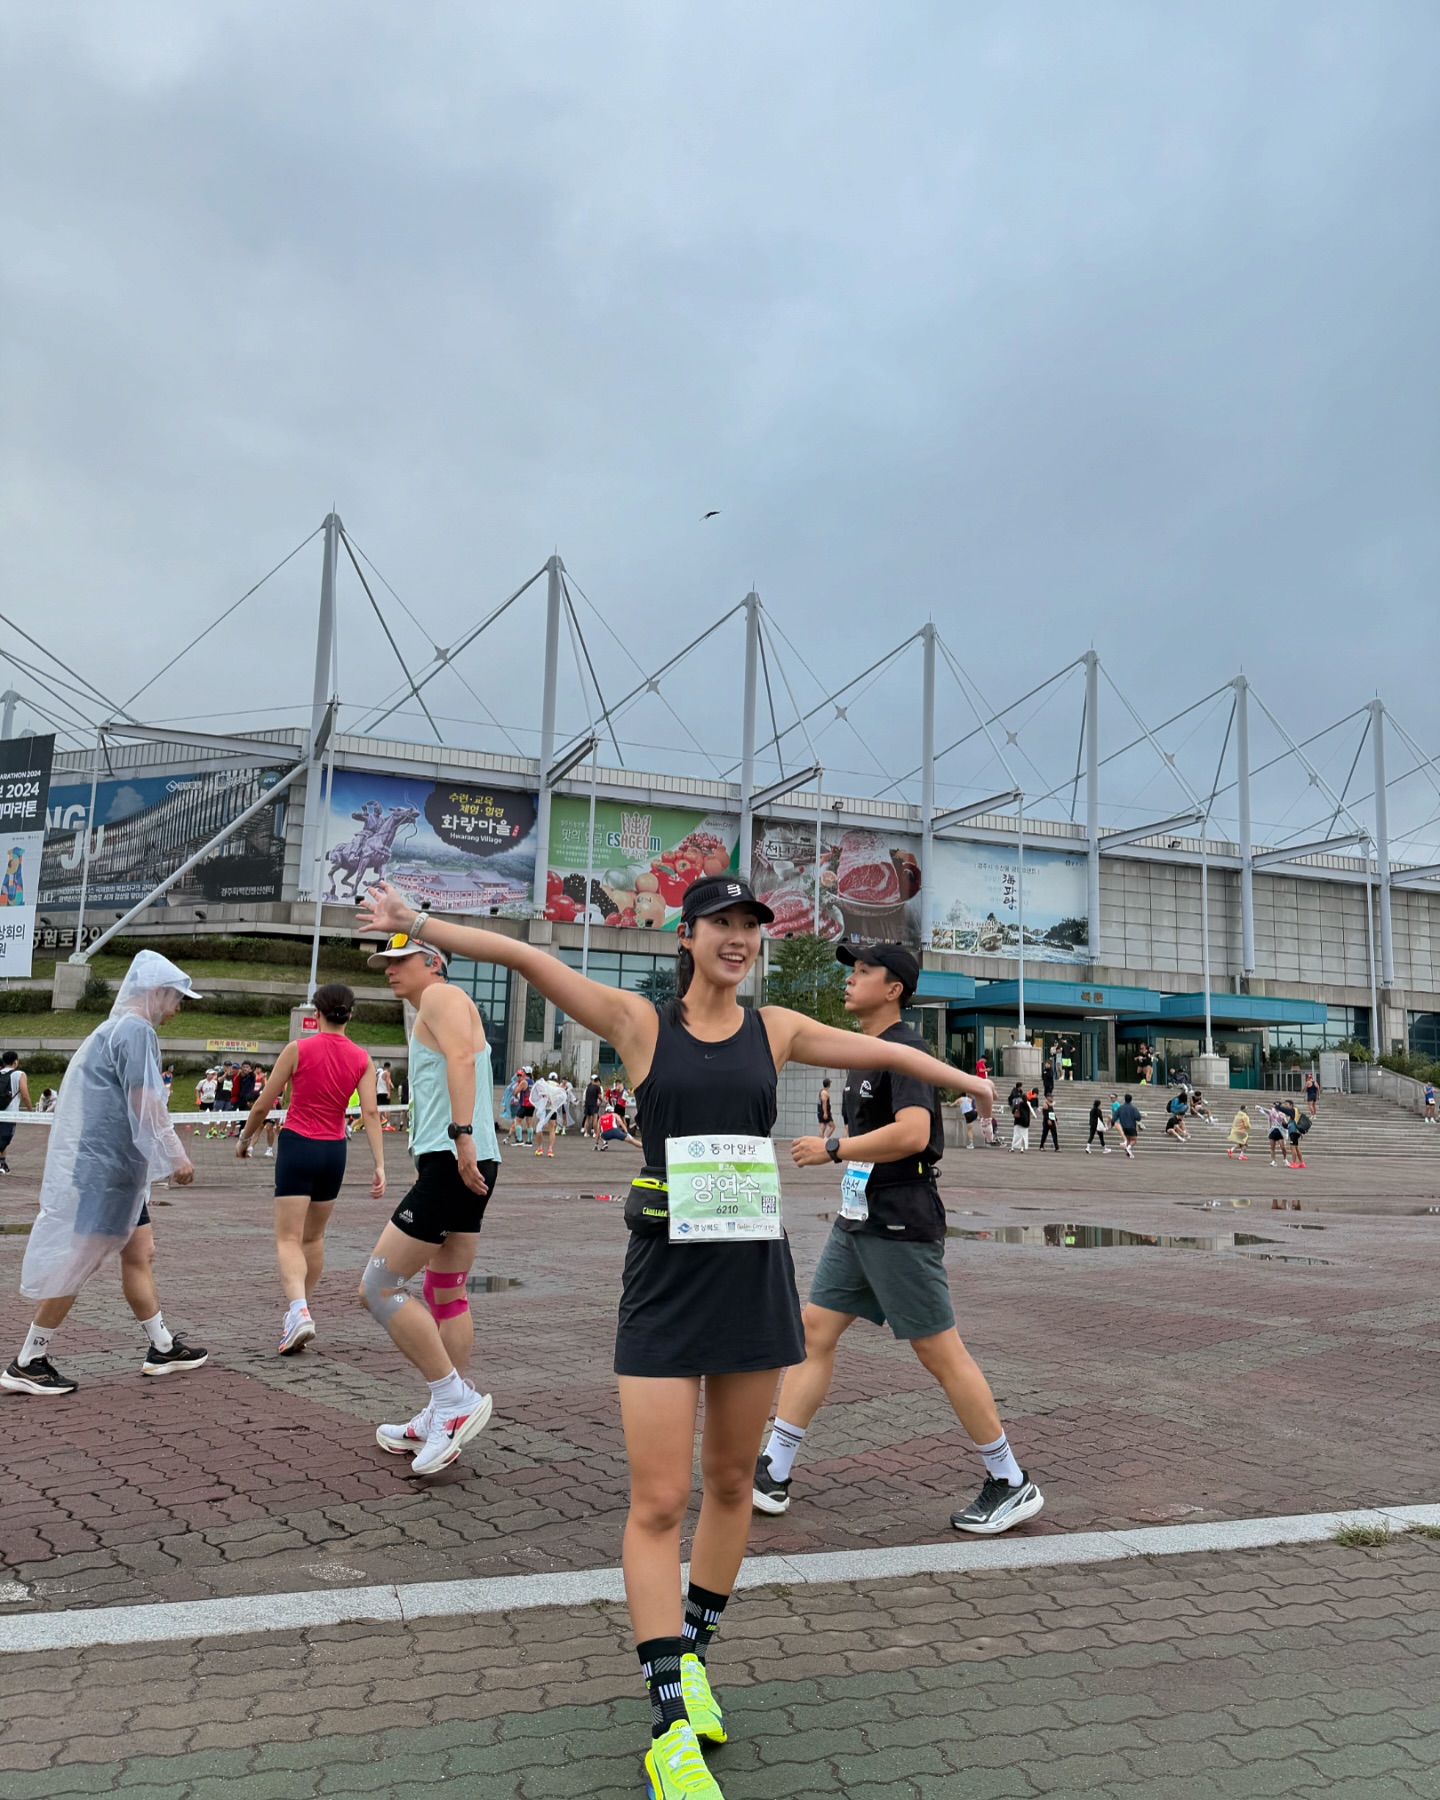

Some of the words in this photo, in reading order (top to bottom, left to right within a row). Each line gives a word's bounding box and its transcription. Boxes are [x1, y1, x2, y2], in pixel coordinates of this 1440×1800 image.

[27, 769, 42, 778] 2024
[6, 781, 40, 798] 2024
[441, 814, 512, 837] 화랑마을
[450, 832, 480, 843] Hwarang
[480, 835, 503, 845] Village
[61, 824, 105, 870] JU
[710, 1143, 758, 1156] 동아일보
[691, 1173, 761, 1203] 양연수
[716, 1204, 739, 1215] 6210
